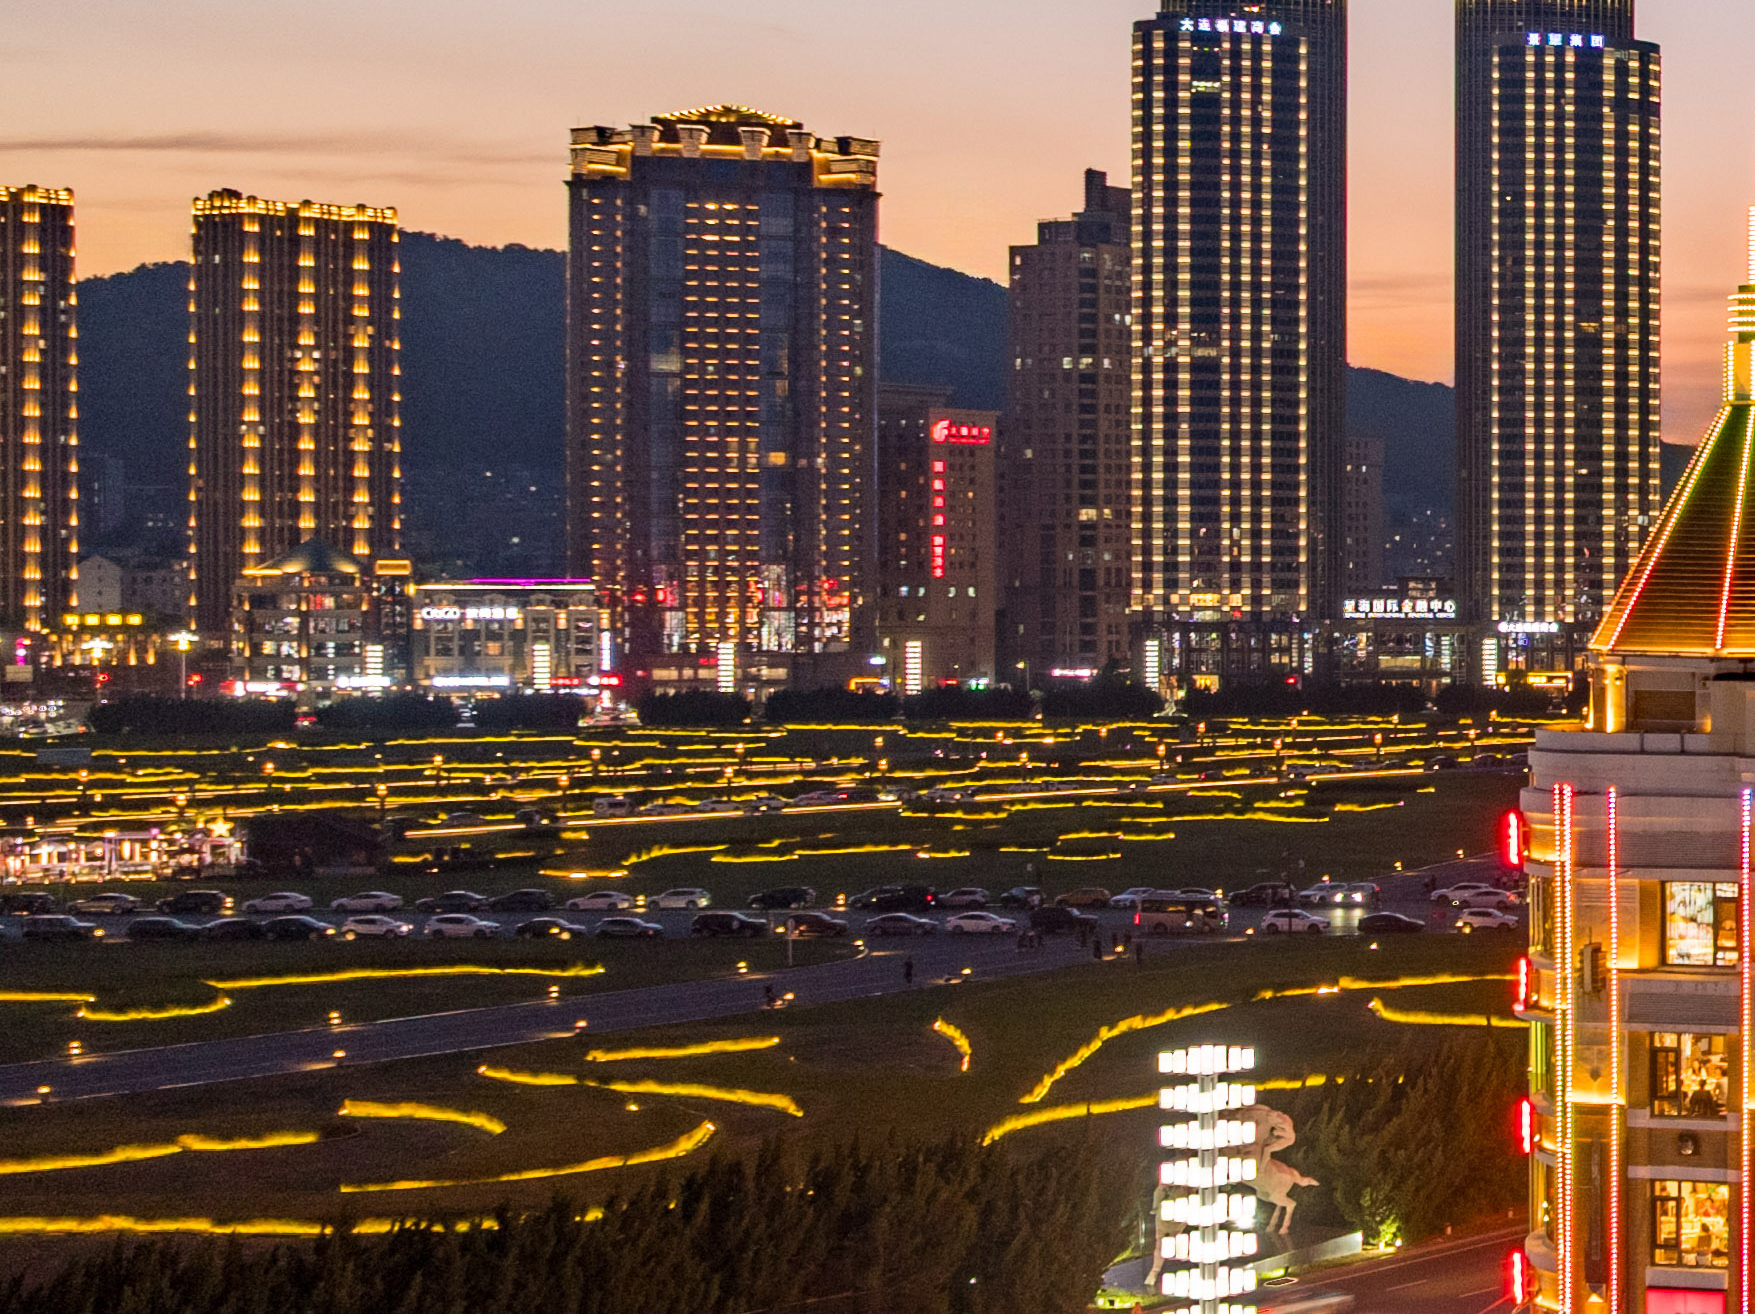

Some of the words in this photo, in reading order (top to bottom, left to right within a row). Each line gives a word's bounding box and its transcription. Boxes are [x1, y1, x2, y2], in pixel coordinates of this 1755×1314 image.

[1180, 18, 1283, 36] 大连福建商会
[1343, 598, 1456, 613] 星海国际金融中心
